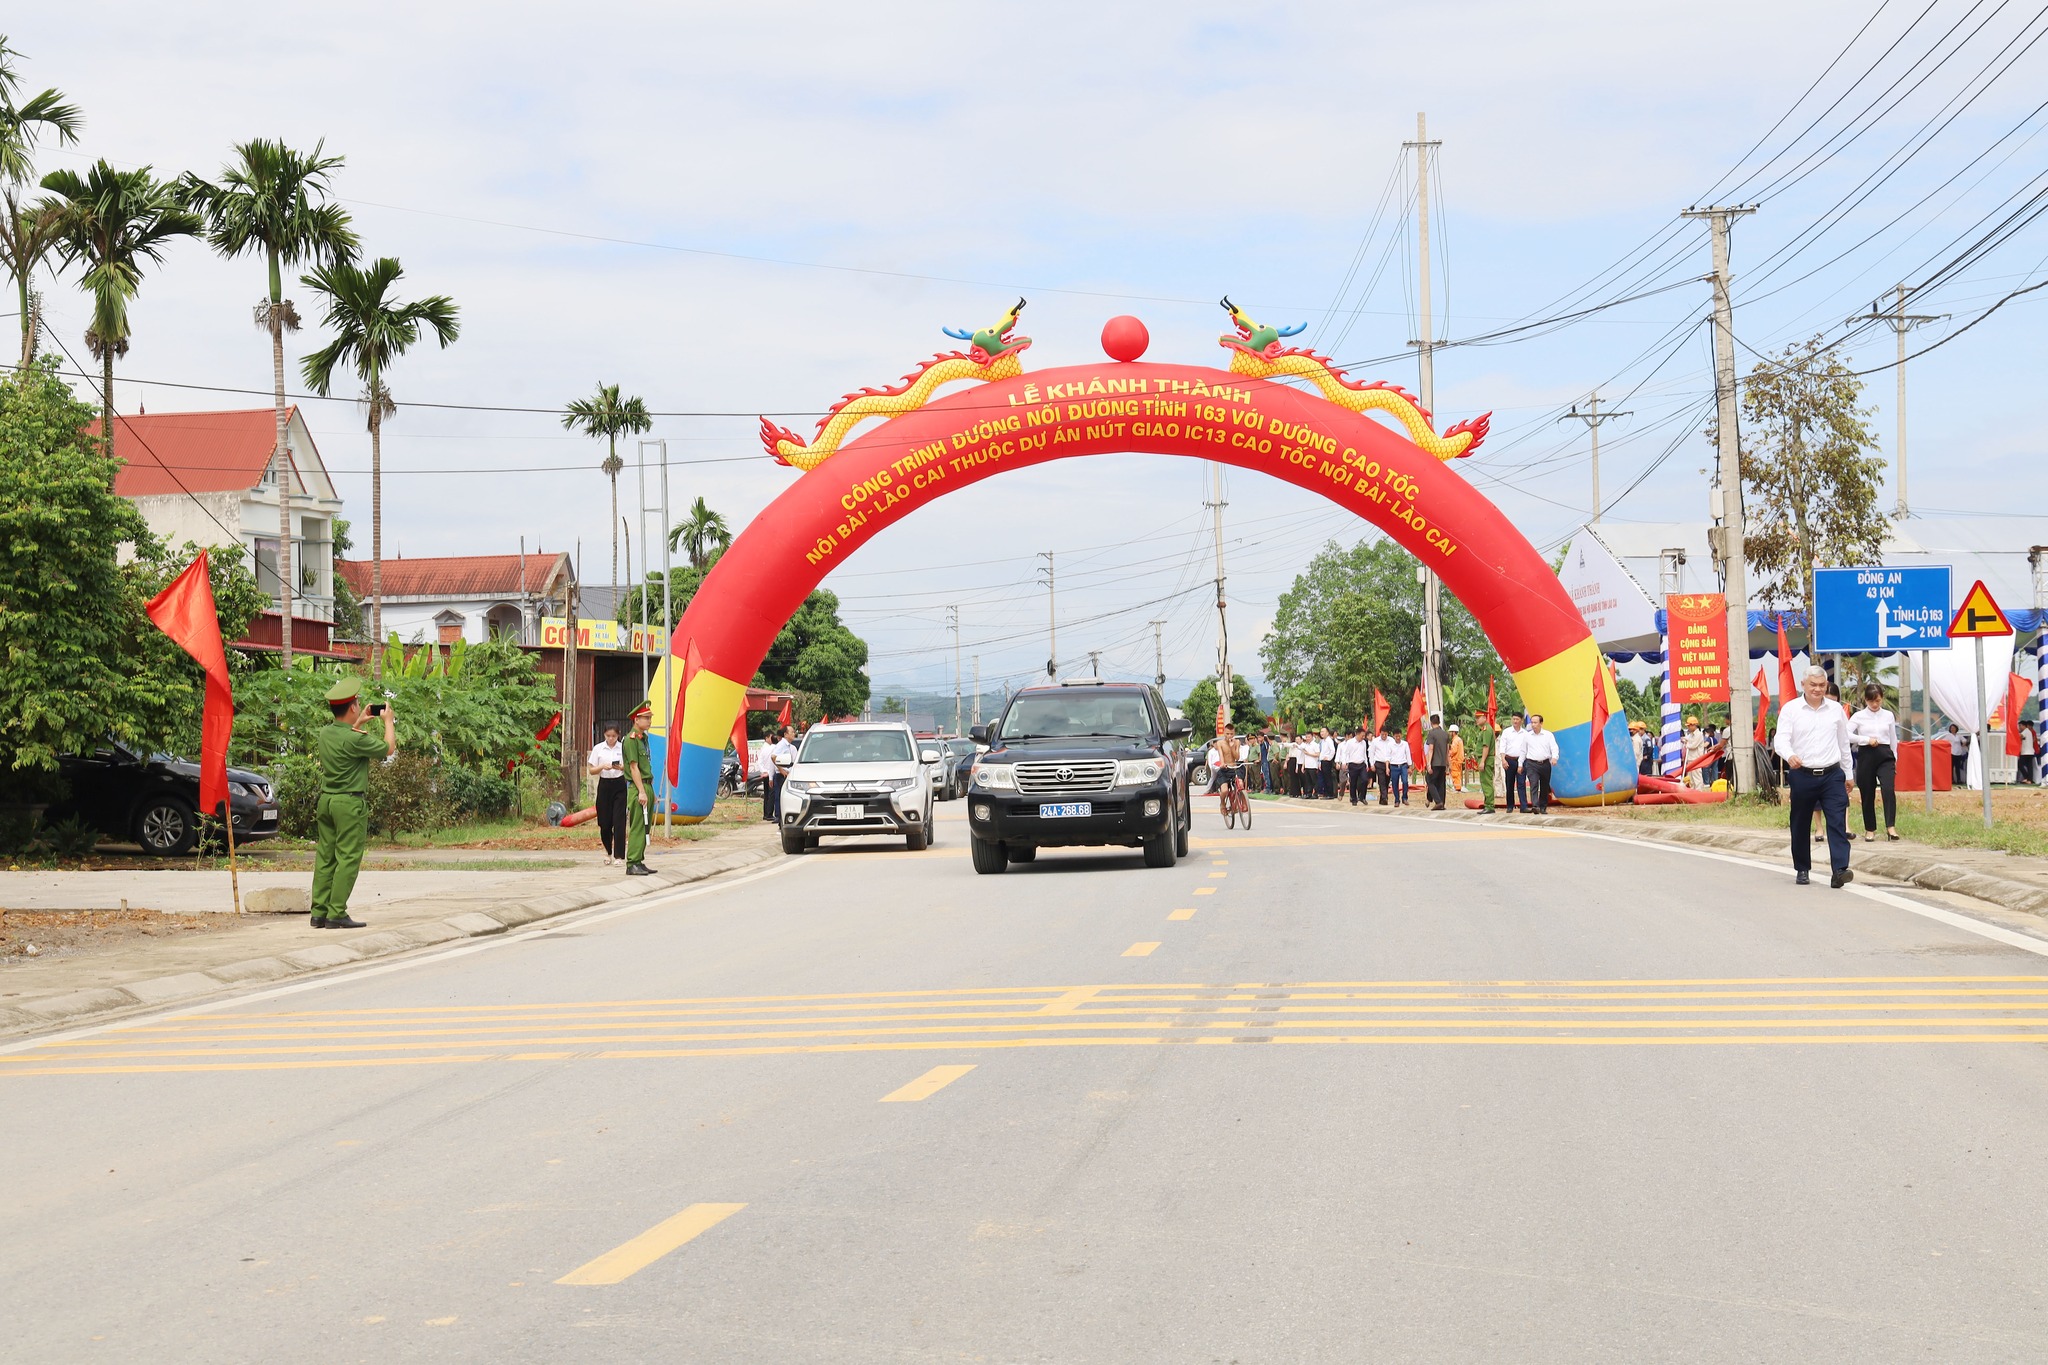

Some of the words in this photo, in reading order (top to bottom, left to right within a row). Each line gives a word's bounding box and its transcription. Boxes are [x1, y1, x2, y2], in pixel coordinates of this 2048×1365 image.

[1008, 383, 1042, 407] LỄ
[1047, 377, 1147, 400] KHÁNH
[1153, 378, 1252, 405] THÀNH
[841, 469, 893, 511] CÔNG
[890, 440, 948, 478] TRÌNH
[951, 414, 1022, 450] ĐƯỜNG
[1026, 402, 1062, 425] NỐI
[1068, 398, 1139, 421] ĐƯỜNG
[1142, 393, 1187, 417] TỈNH
[1193, 403, 1226, 423] 163
[1231, 407, 1265, 430] VỚI
[1268, 418, 1337, 455] ĐƯỜNG
[1342, 447, 1381, 478] CAO
[1384, 468, 1420, 501] TỐC
[805, 534, 838, 565] NỘI
[836, 510, 868, 540] BÀI
[873, 484, 911, 514] LÀO
[913, 465, 946, 490] CAI
[949, 441, 1015, 473] THUỘC
[1019, 430, 1047, 451] DỰ
[1053, 425, 1085, 445] ÁN
[1086, 422, 1127, 440] NÚT
[1131, 422, 1180, 438] GIAO
[1184, 424, 1226, 444] IC13
[1231, 431, 1273, 455] CAO
[1279, 445, 1317, 470] TỐC
[1318, 460, 1354, 487] NỘI
[1425, 528, 1458, 557] CAI
[1887, 572, 1902, 584] AN
[1866, 587, 1877, 599] 43
[1879, 586, 1895, 598] KM
[1892, 605, 1915, 621] TỈNH
[1916, 605, 1929, 623] LỘ
[1929, 609, 1943, 621] 163
[1687, 623, 1708, 635] ĐẢNG
[1919, 626, 1925, 638] 2
[1927, 626, 1942, 637] KM
[1680, 638, 1700, 650] CỘNG
[1701, 636, 1717, 648] SẢN
[1681, 651, 1697, 663] VIỆT
[1698, 652, 1716, 661] NAM
[1678, 666, 1702, 676] QUANG
[1703, 665, 1720, 675] VINH
[1677, 678, 1699, 689] MUÔN
[1700, 678, 1718, 688] NĂM
